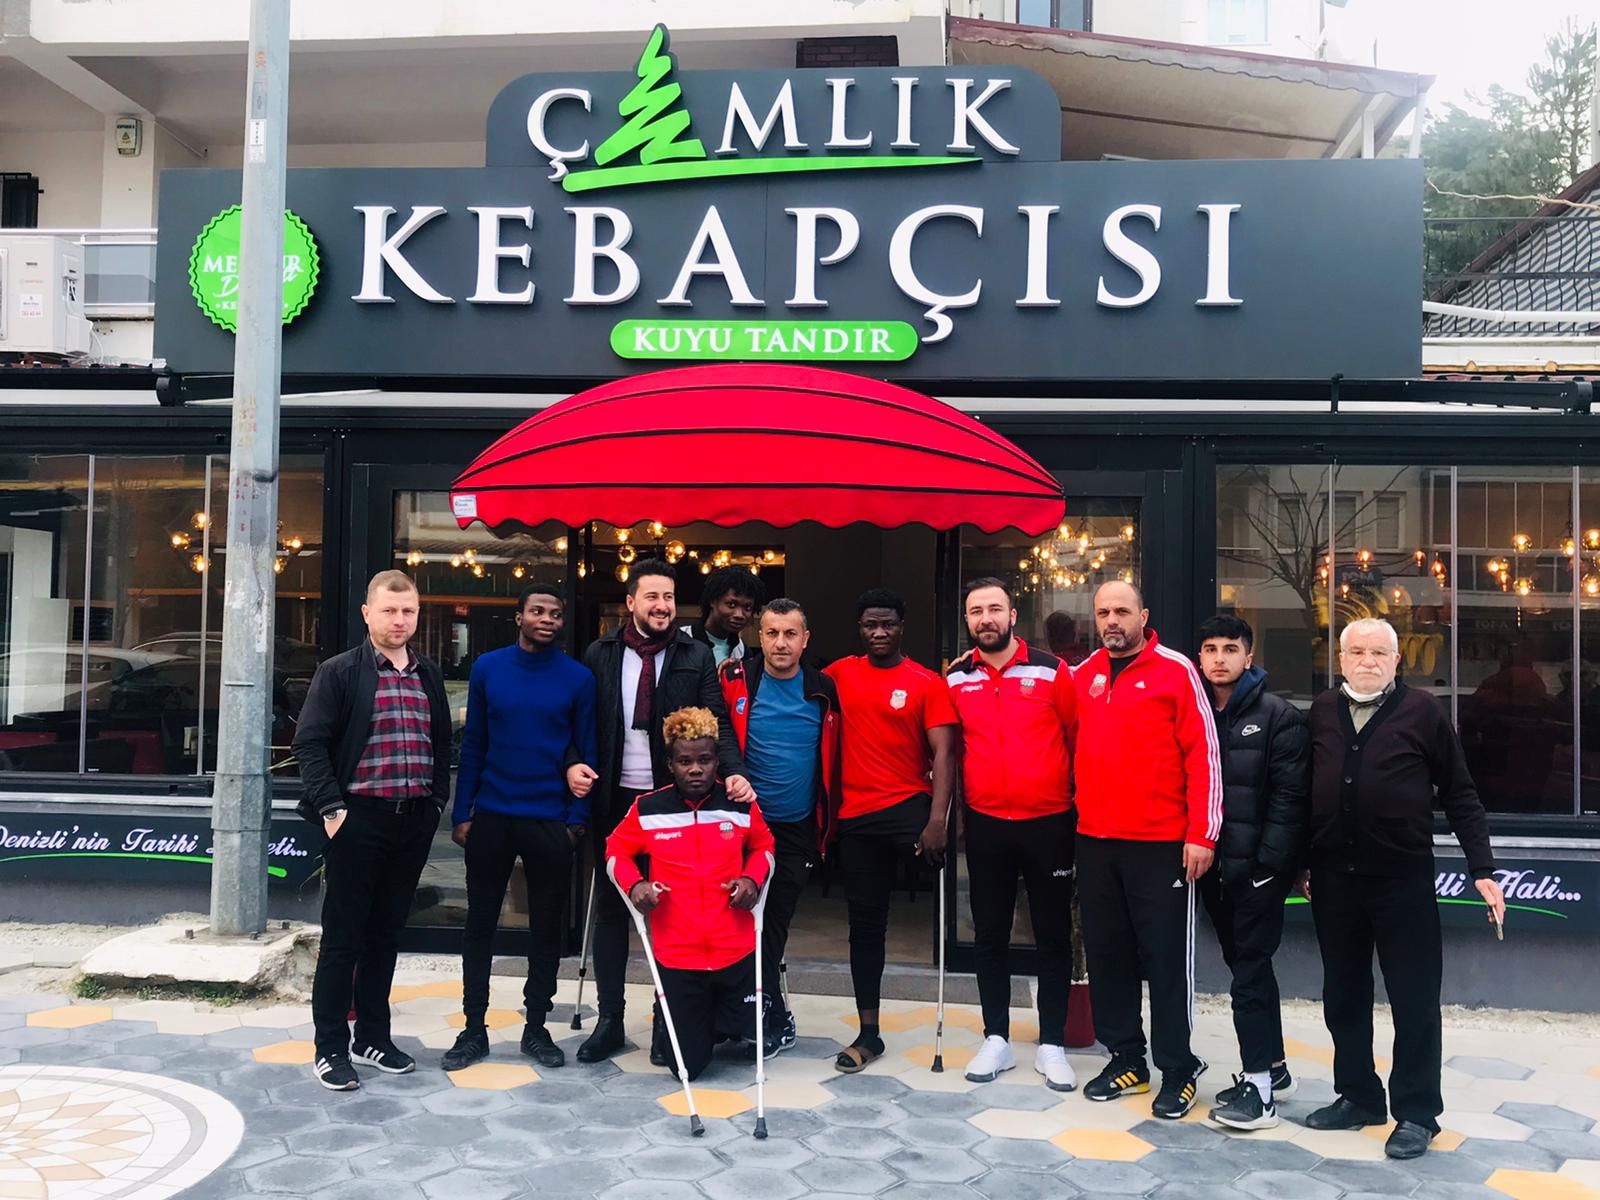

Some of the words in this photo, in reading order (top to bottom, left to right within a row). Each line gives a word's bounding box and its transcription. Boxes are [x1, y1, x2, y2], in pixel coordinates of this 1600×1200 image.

[202, 254, 304, 273] MER
[351, 203, 1244, 344] KEBAPÇISI
[632, 327, 733, 352] KUYU
[745, 328, 895, 353] TANDIR
[121, 828, 199, 853] Tarihi
